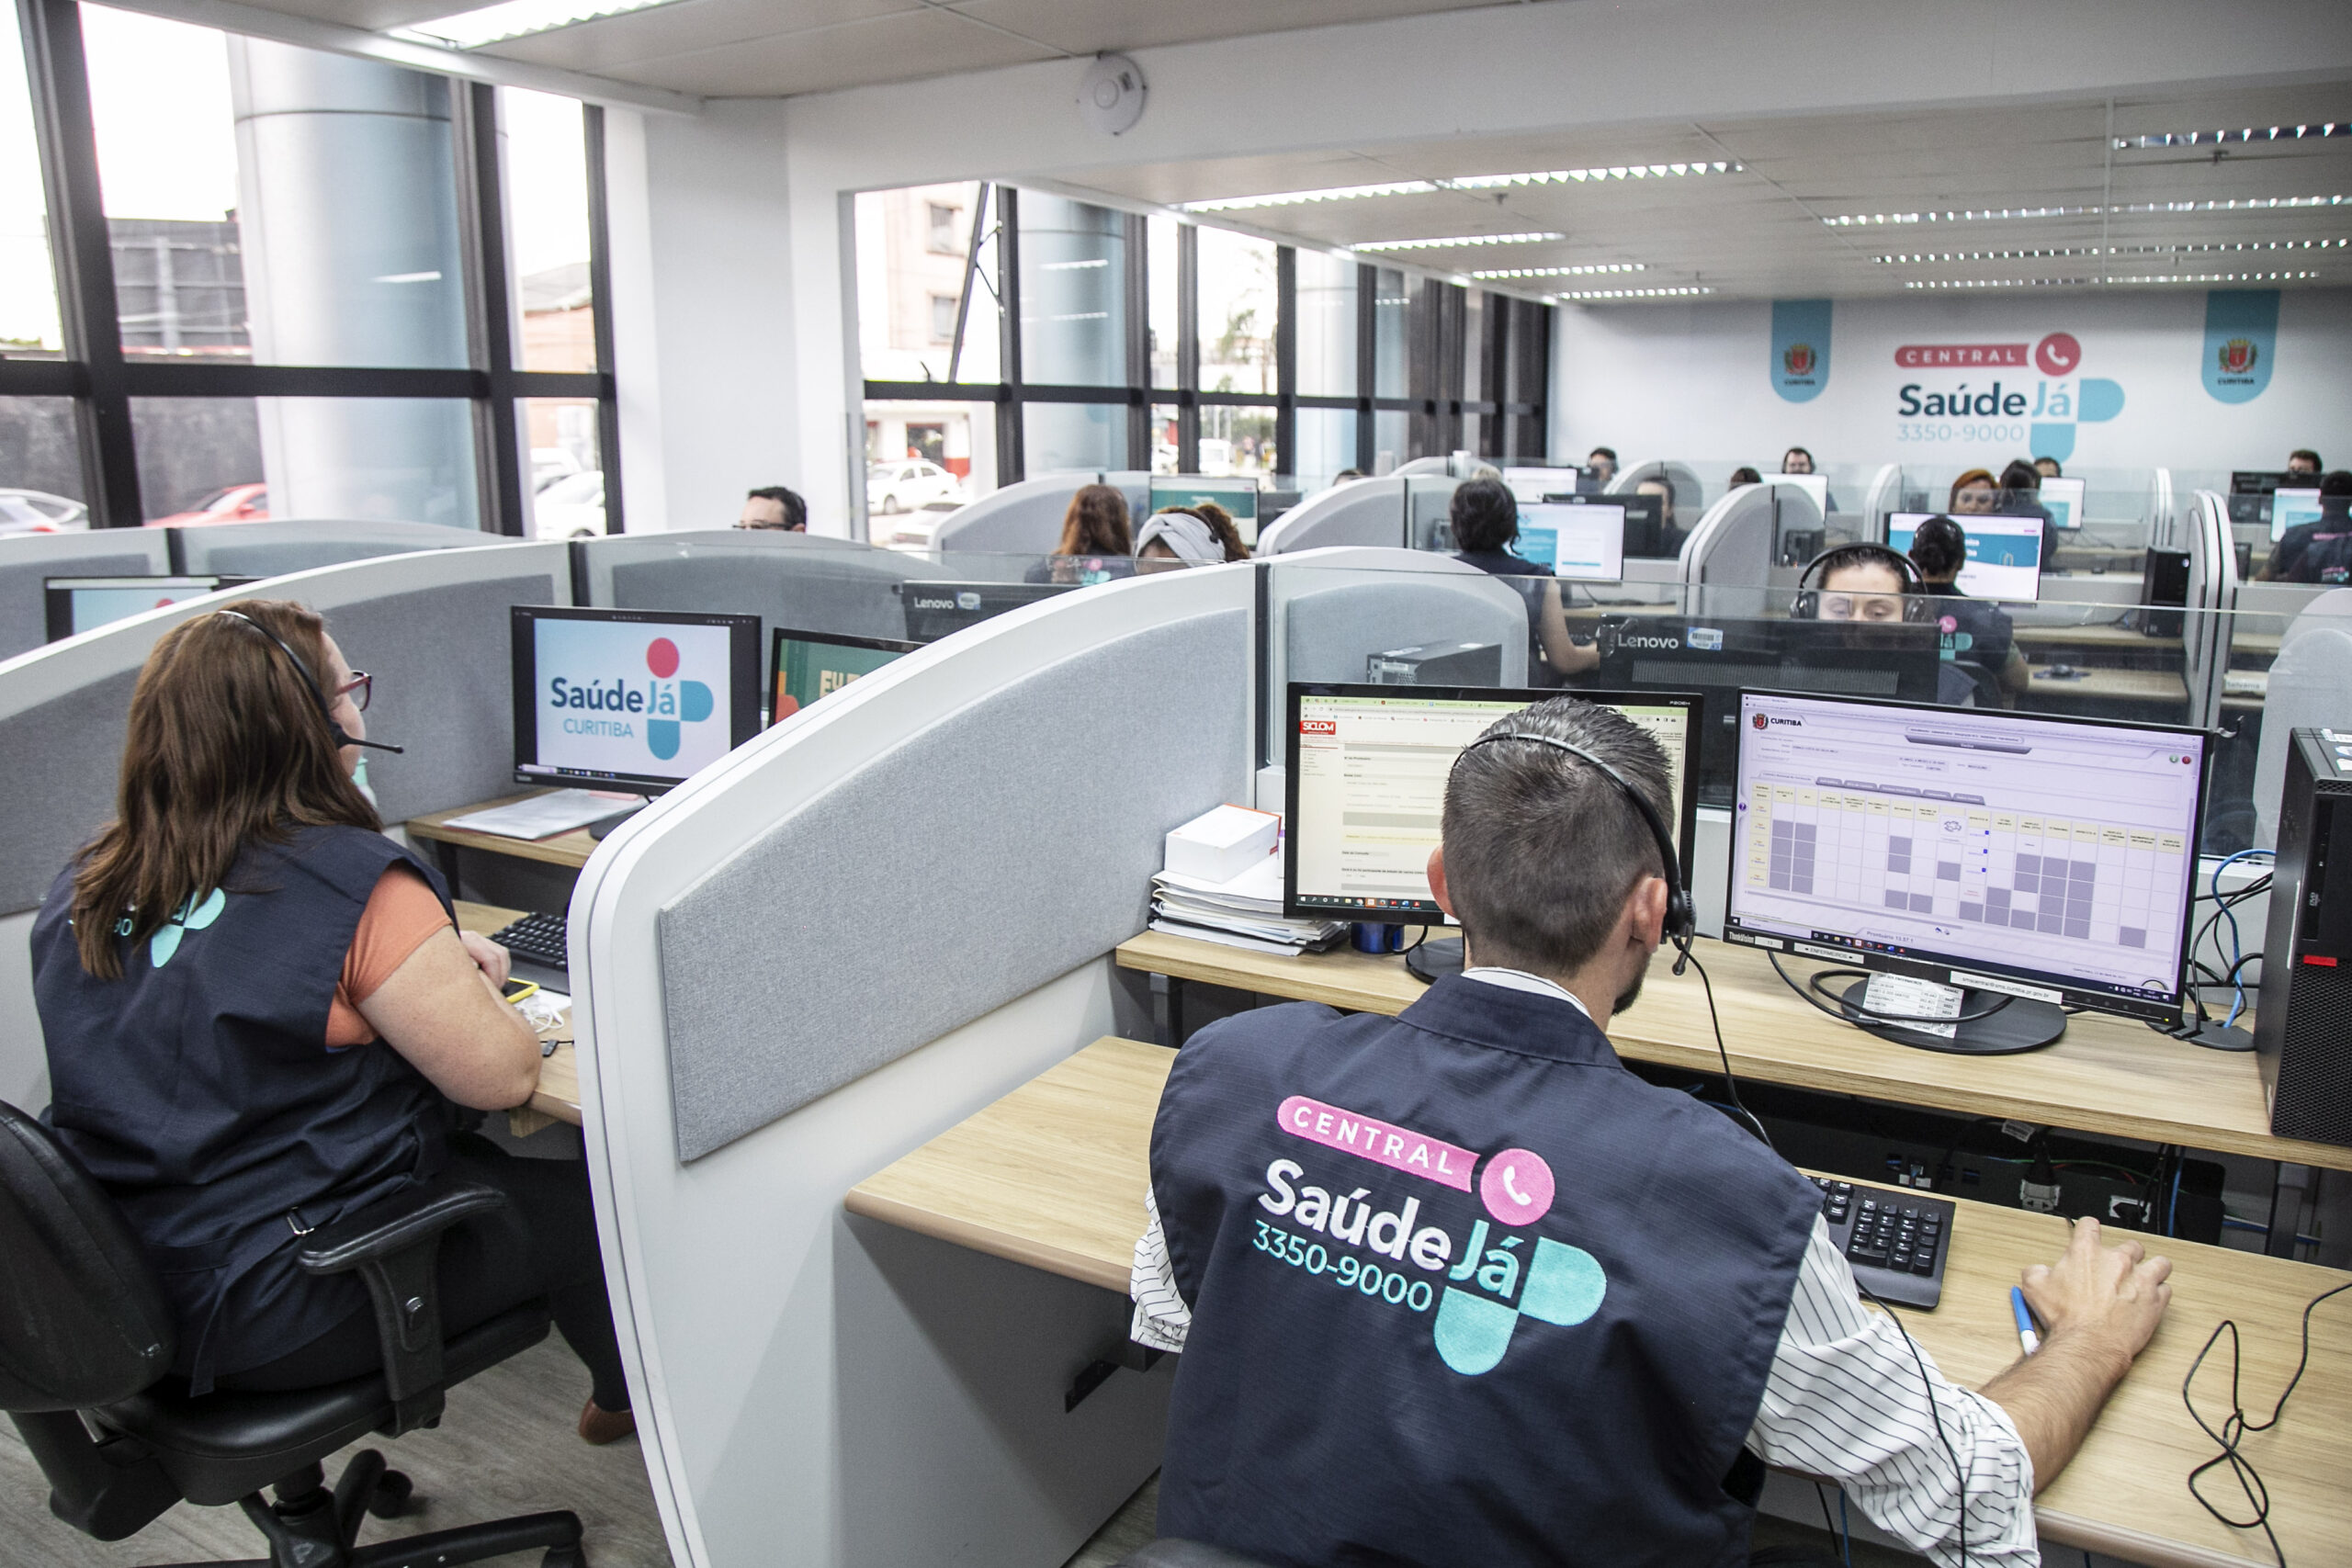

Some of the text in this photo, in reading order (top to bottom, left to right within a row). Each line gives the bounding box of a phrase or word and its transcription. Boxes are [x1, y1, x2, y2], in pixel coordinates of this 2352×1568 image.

[1905, 348, 2016, 364] CENTRAL
[1898, 379, 2071, 418] Saúde Já
[1897, 423, 2025, 443] 3350-9000
[913, 596, 955, 610] Lenovo
[1617, 633, 1679, 649] Lenovo
[550, 677, 676, 716] Saúde Já
[563, 717, 634, 739] CURITIBA
[1302, 721, 1334, 732] SICLOM
[1770, 717, 1802, 728] CURITIBA
[1728, 931, 1755, 944] ThinkVision
[1294, 1105, 1453, 1176] CENTRAL
[1258, 1157, 1524, 1299] Saúde Já
[1252, 1219, 1433, 1314] 3350-9000
